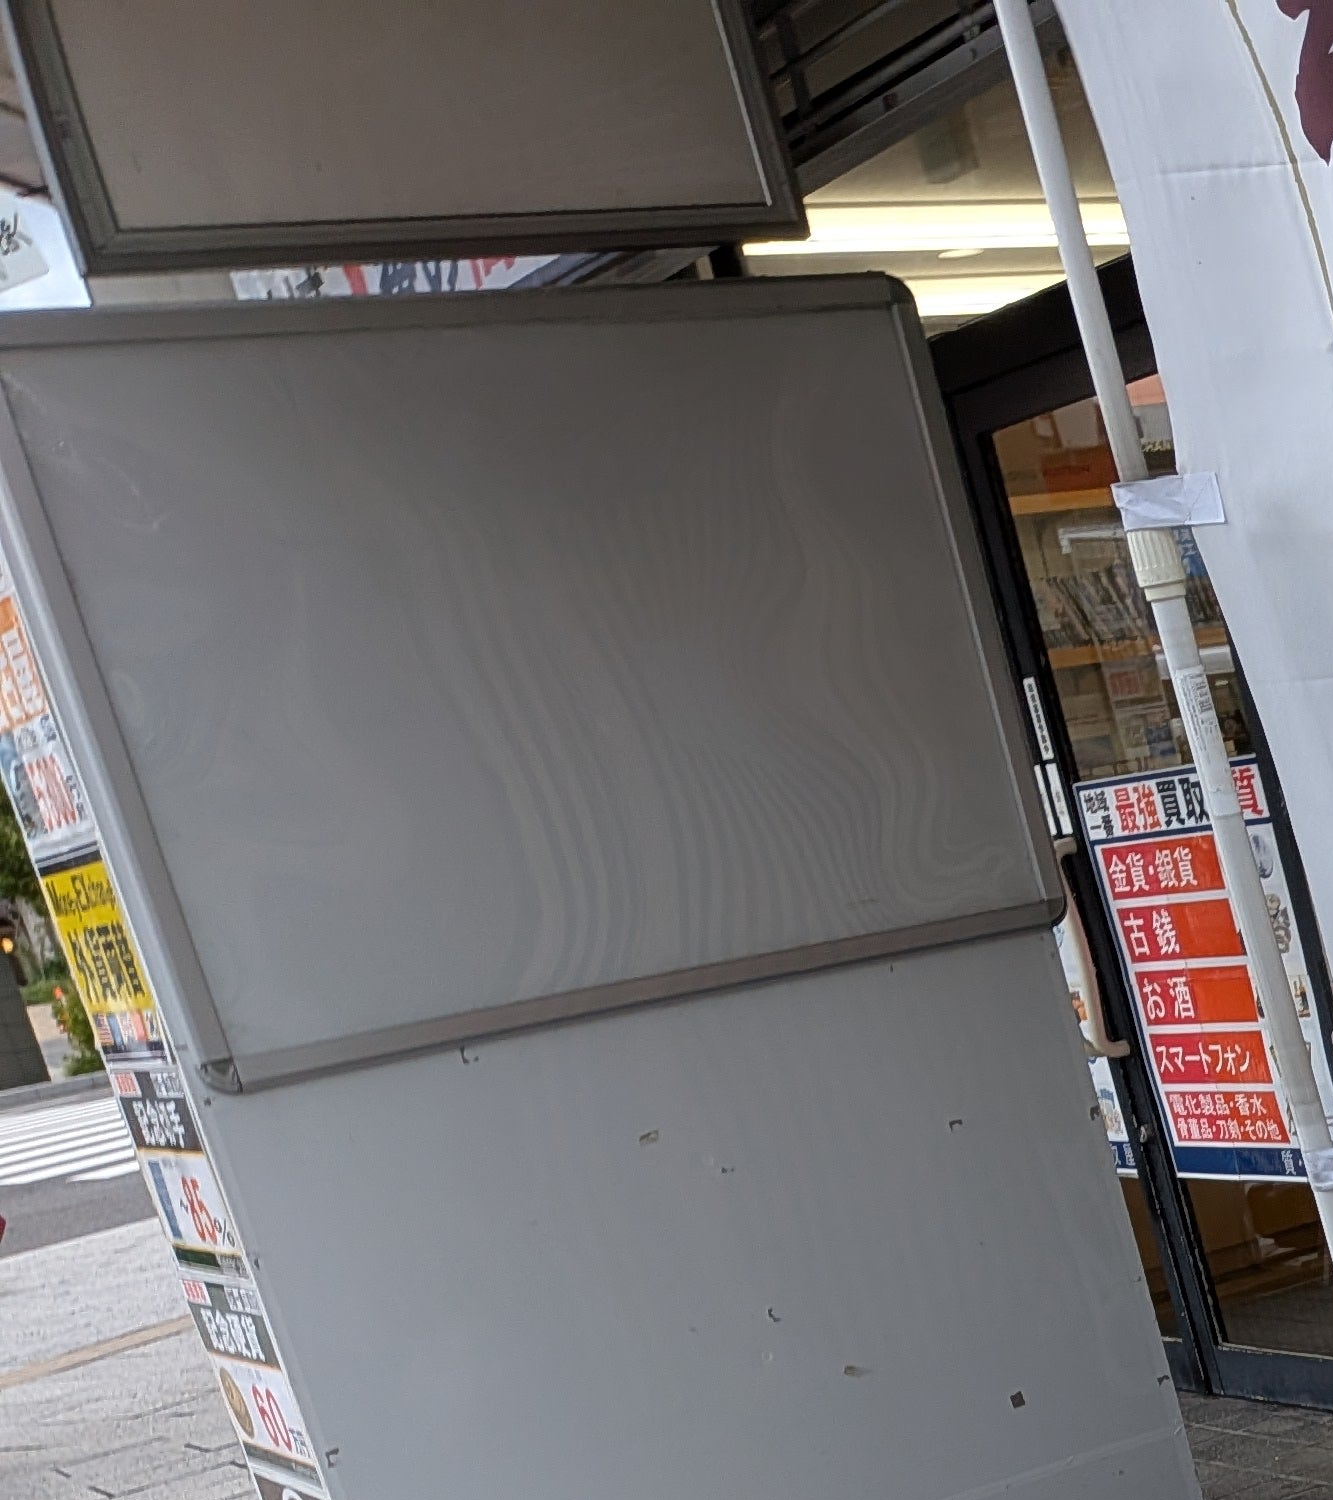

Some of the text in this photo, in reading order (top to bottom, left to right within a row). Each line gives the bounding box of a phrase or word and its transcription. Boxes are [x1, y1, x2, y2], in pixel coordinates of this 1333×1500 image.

[1143, 976, 1196, 1021] お酒
[1155, 1042, 1251, 1076] スマートフォン
